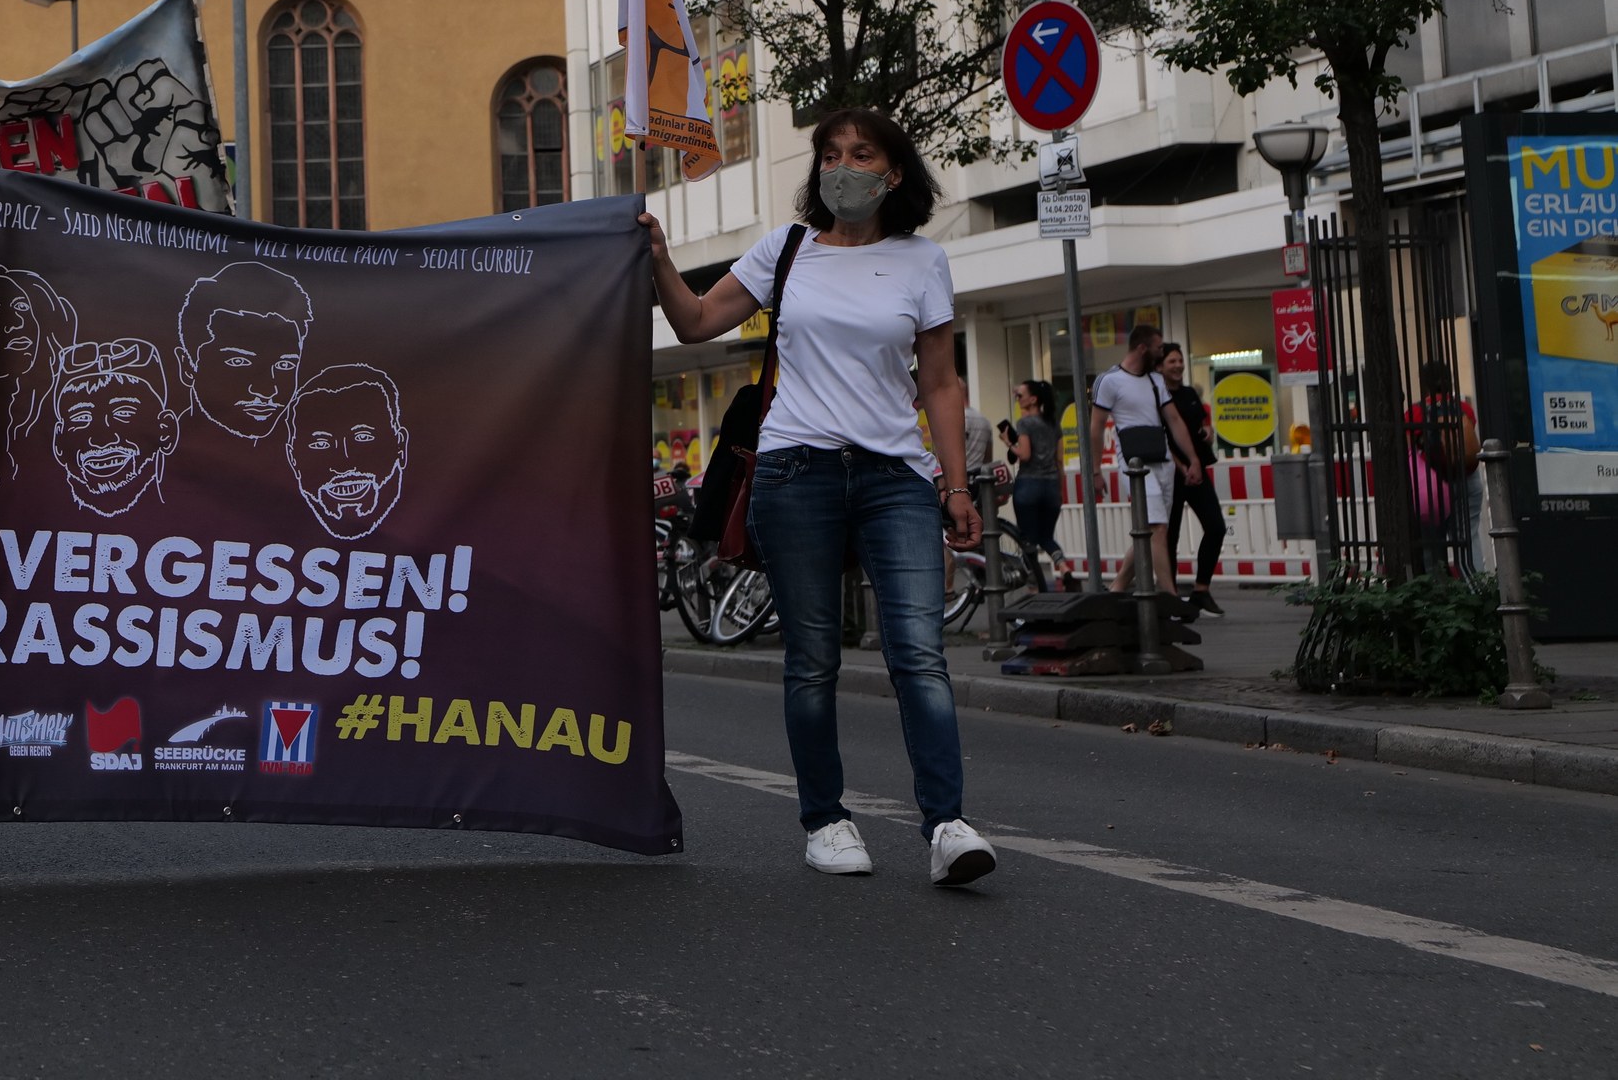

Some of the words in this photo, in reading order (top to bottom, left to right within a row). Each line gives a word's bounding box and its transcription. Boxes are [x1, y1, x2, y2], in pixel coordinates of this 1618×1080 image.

[649, 115, 686, 130] adınlar
[649, 129, 719, 152] migrantinnen
[1521, 145, 1618, 190] MU
[1042, 195, 1051, 203] Ab
[1053, 194, 1086, 203] Dienstag
[1524, 193, 1618, 214] ERLAU
[1044, 204, 1083, 214] 14.04.2020
[1527, 218, 1568, 237] EIN
[62, 207, 101, 238] SAID
[106, 213, 153, 245] NESAR
[158, 221, 229, 254] HASHEMI
[254, 238, 288, 259] VILI
[295, 243, 348, 264] VIOREL
[420, 247, 468, 270] SEDAT
[472, 246, 534, 274] GÜRBÜZ
[1561, 294, 1618, 316] CAM
[1550, 397, 1566, 408] 55
[1568, 400, 1586, 408] STK
[1551, 415, 1568, 428] 15
[1570, 421, 1588, 429] EUR
[1541, 498, 1591, 511] STRÖER
[333, 693, 633, 765] #HANAU
[9, 746, 28, 757] GEGEN
[29, 746, 52, 757] RECHTS
[154, 745, 246, 761] SEEBRÜCKE
[90, 752, 143, 771] SDAJ
[154, 762, 203, 771] FRANKFURT
[205, 763, 219, 771] AM
[221, 763, 245, 771] MAIN
